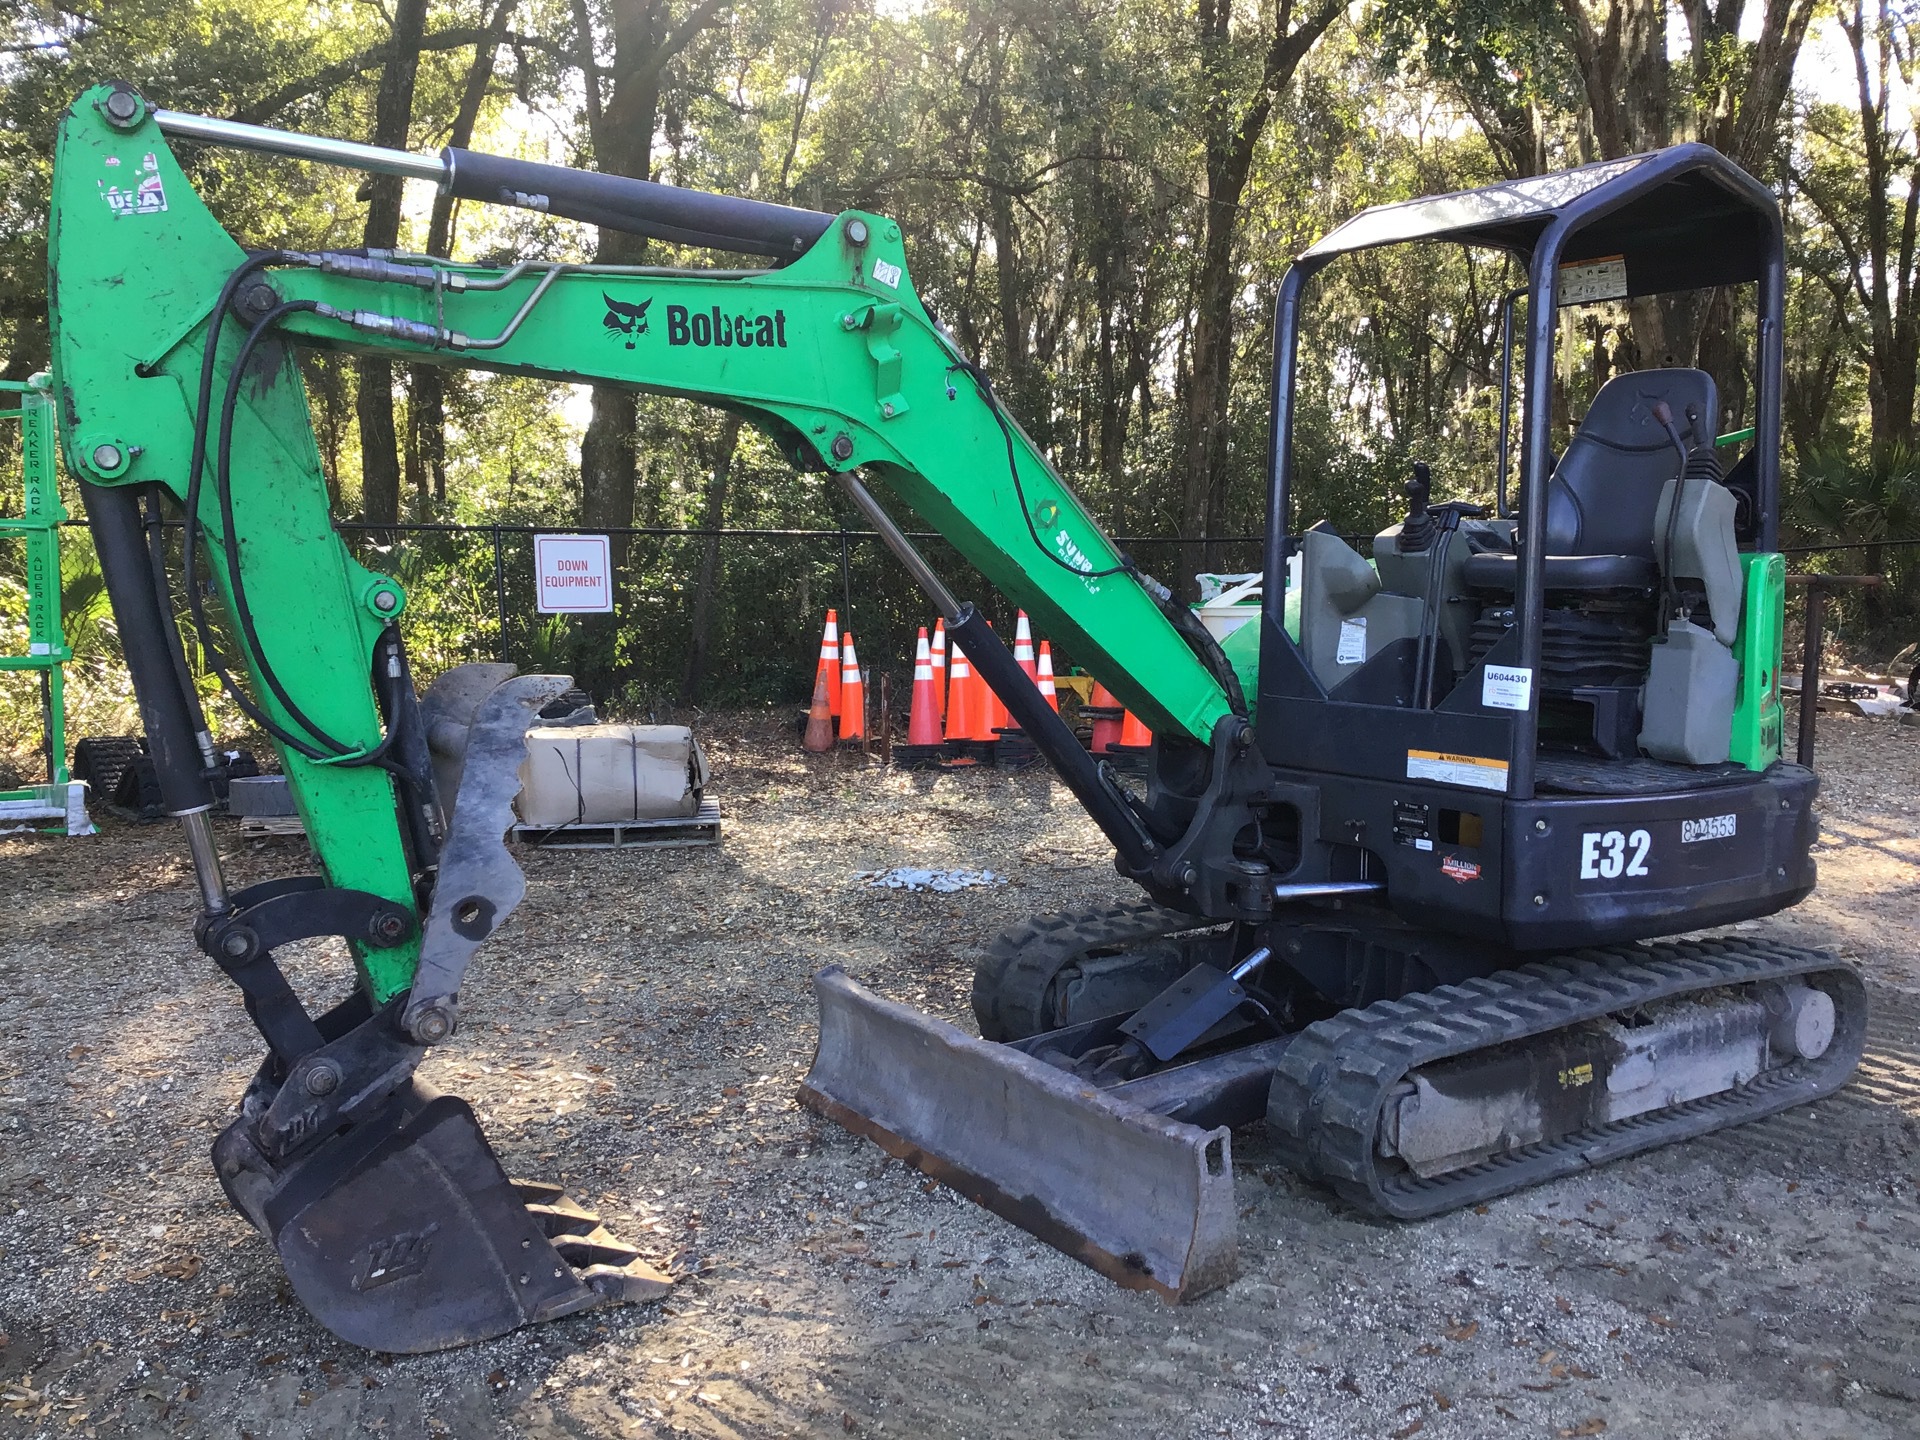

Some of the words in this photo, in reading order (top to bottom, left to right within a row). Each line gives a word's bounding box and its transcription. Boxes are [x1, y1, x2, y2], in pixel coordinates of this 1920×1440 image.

[667, 304, 787, 348] Bobcat
[29, 475, 42, 516] RACK
[558, 560, 588, 571] DOWN
[33, 556, 43, 599] AUGER
[545, 576, 602, 587] EQUIPMENT
[35, 604, 44, 638] RACK
[1487, 672, 1528, 683] U604430
[1446, 754, 1476, 764] WARNING
[1447, 860, 1477, 870] MILLION
[1580, 829, 1651, 880] E32
